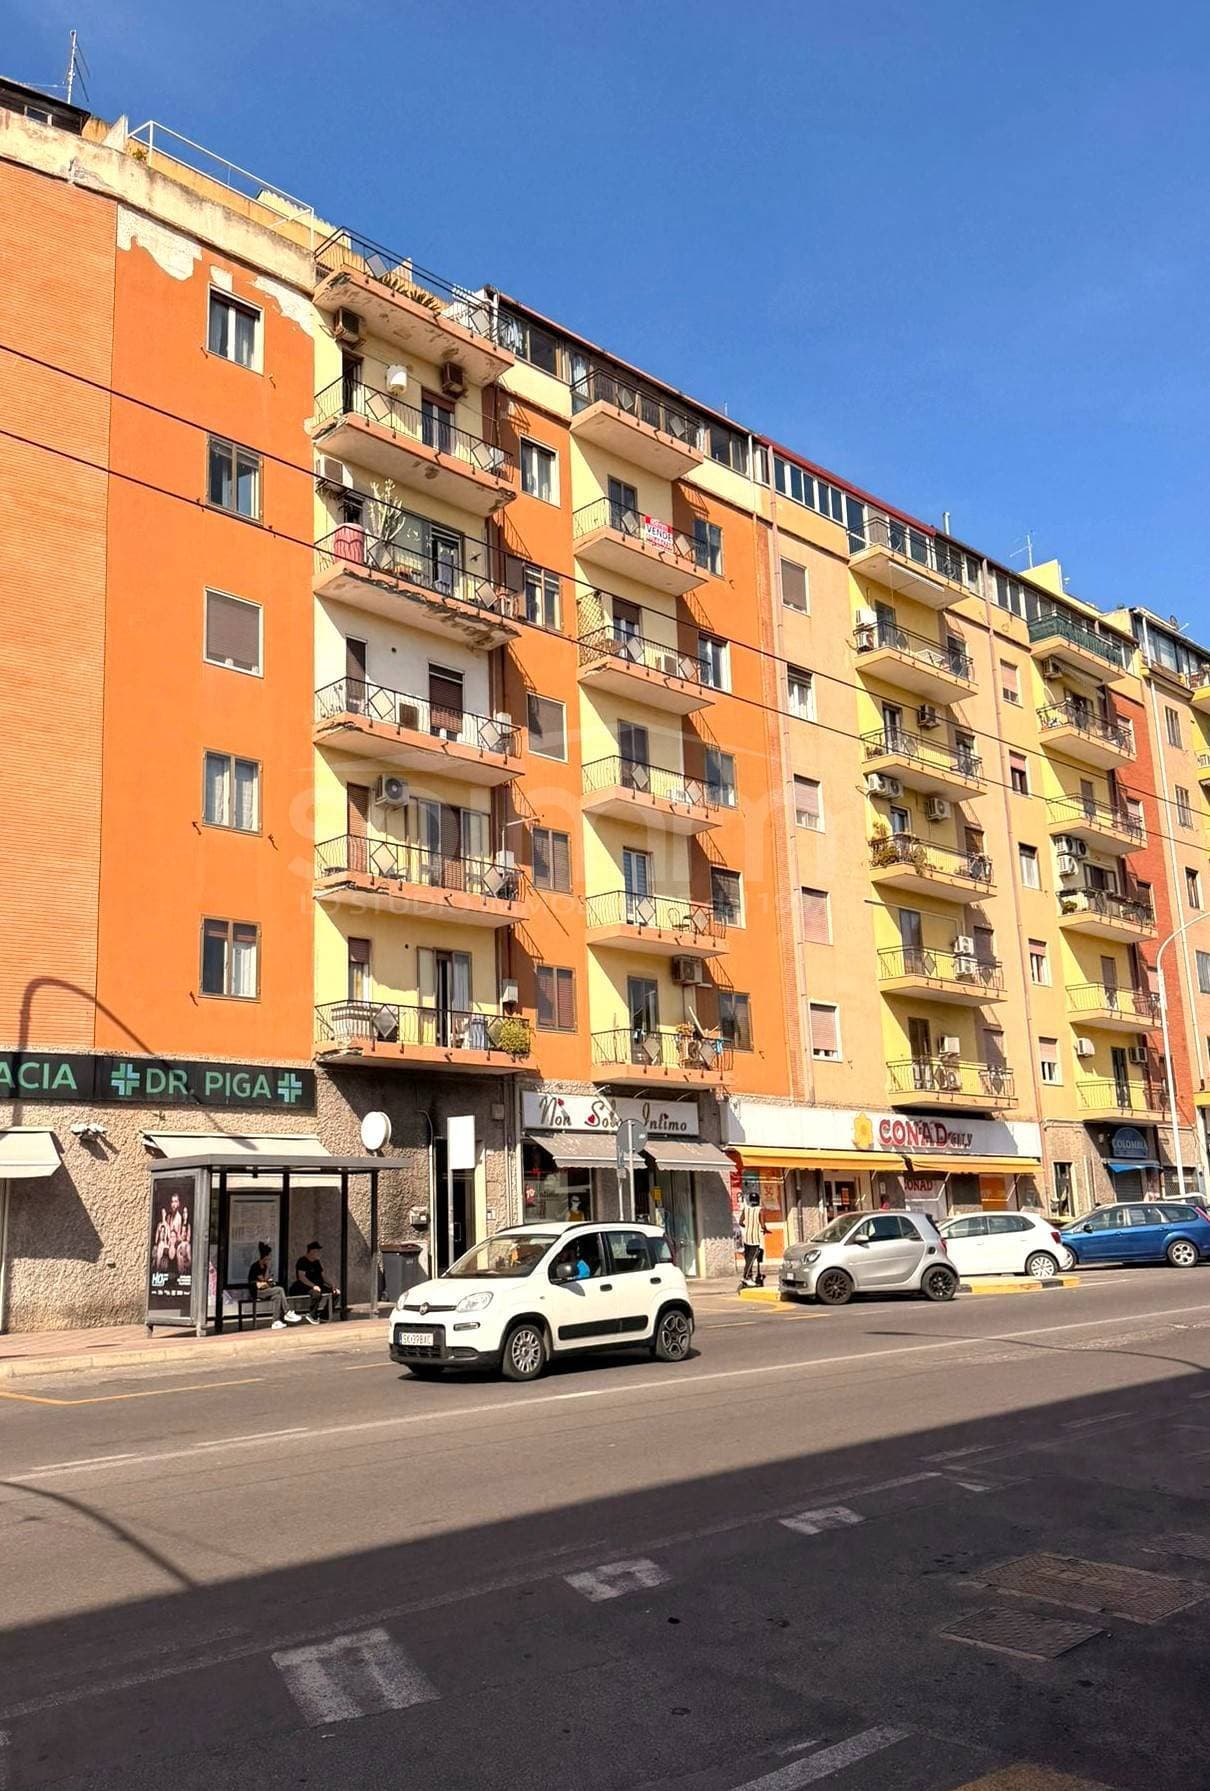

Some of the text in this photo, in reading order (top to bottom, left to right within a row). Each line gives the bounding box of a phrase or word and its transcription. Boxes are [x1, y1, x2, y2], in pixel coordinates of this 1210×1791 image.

[205, 1071, 272, 1099] PIGA
[539, 1096, 572, 1126] Non
[642, 1102, 687, 1131] Intimo
[879, 1119, 948, 1148] CONAD
